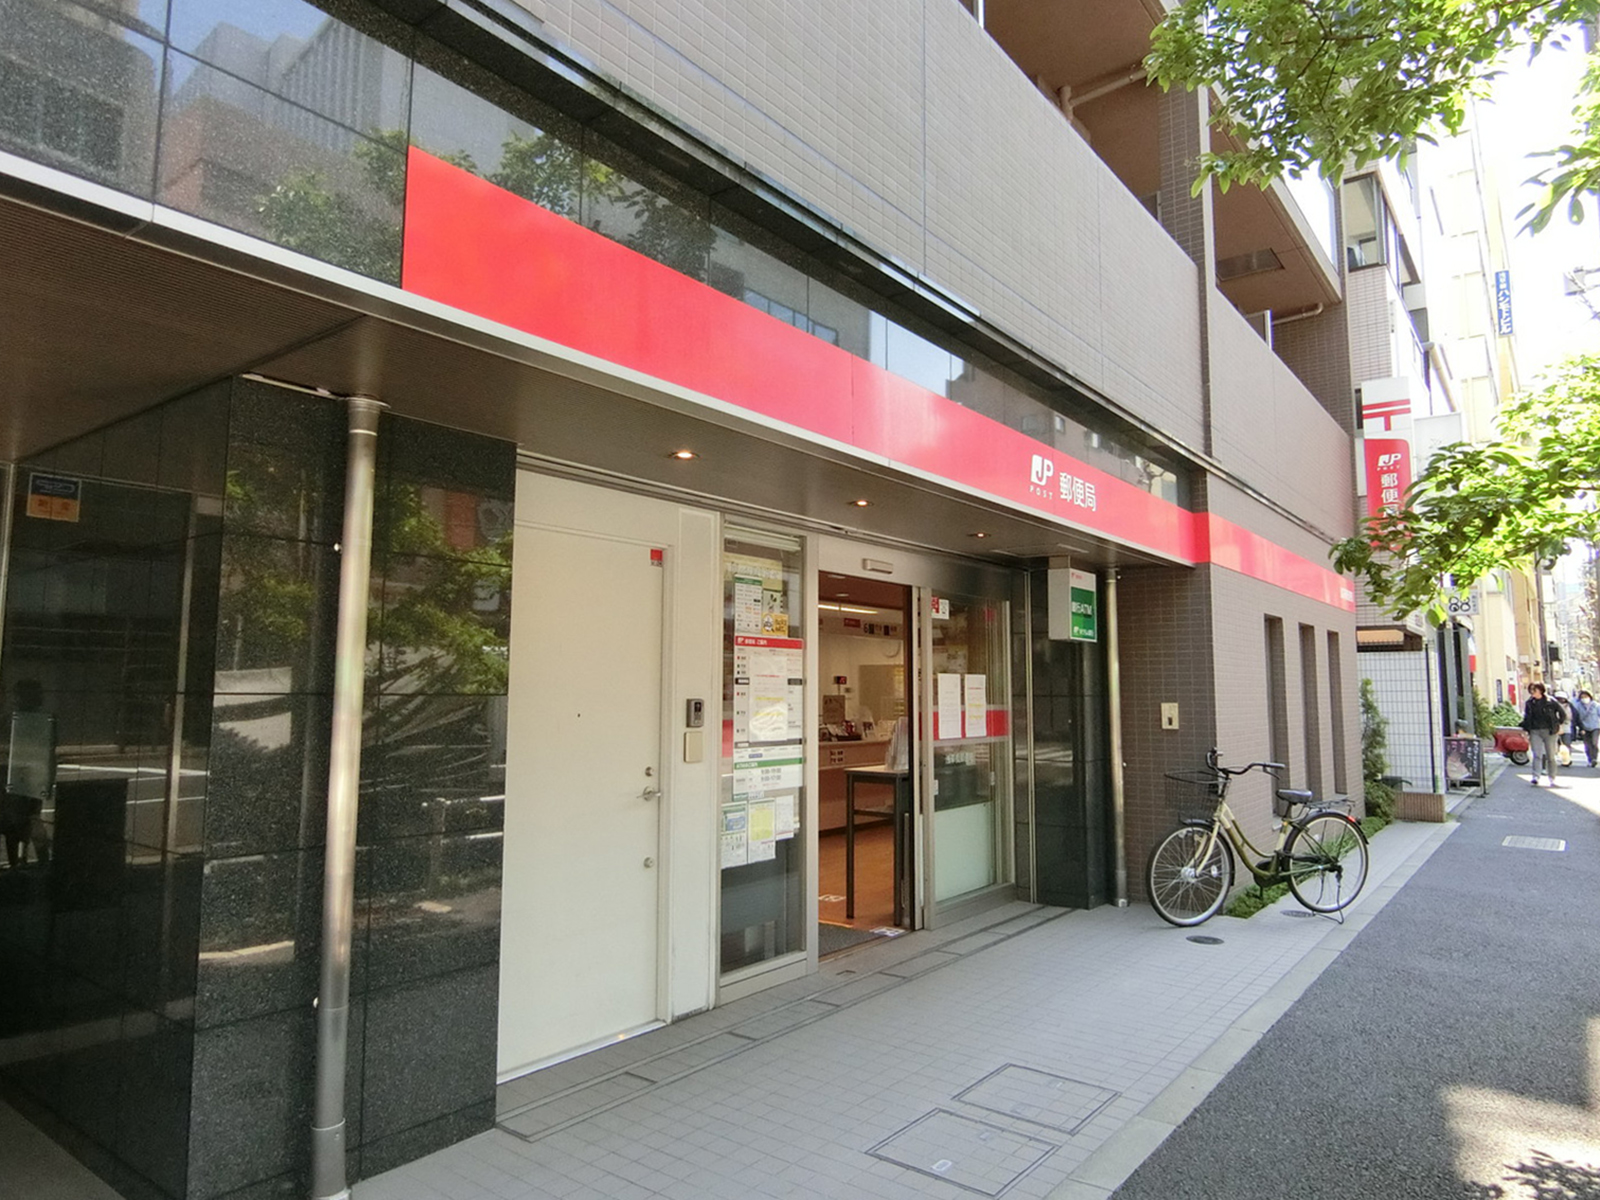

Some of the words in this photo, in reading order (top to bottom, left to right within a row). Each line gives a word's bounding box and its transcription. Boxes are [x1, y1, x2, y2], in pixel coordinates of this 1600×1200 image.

[1030, 454, 1054, 486] JP
[1377, 453, 1402, 466] JP
[1029, 485, 1054, 500] POST
[1059, 472, 1096, 512] 郵便局
